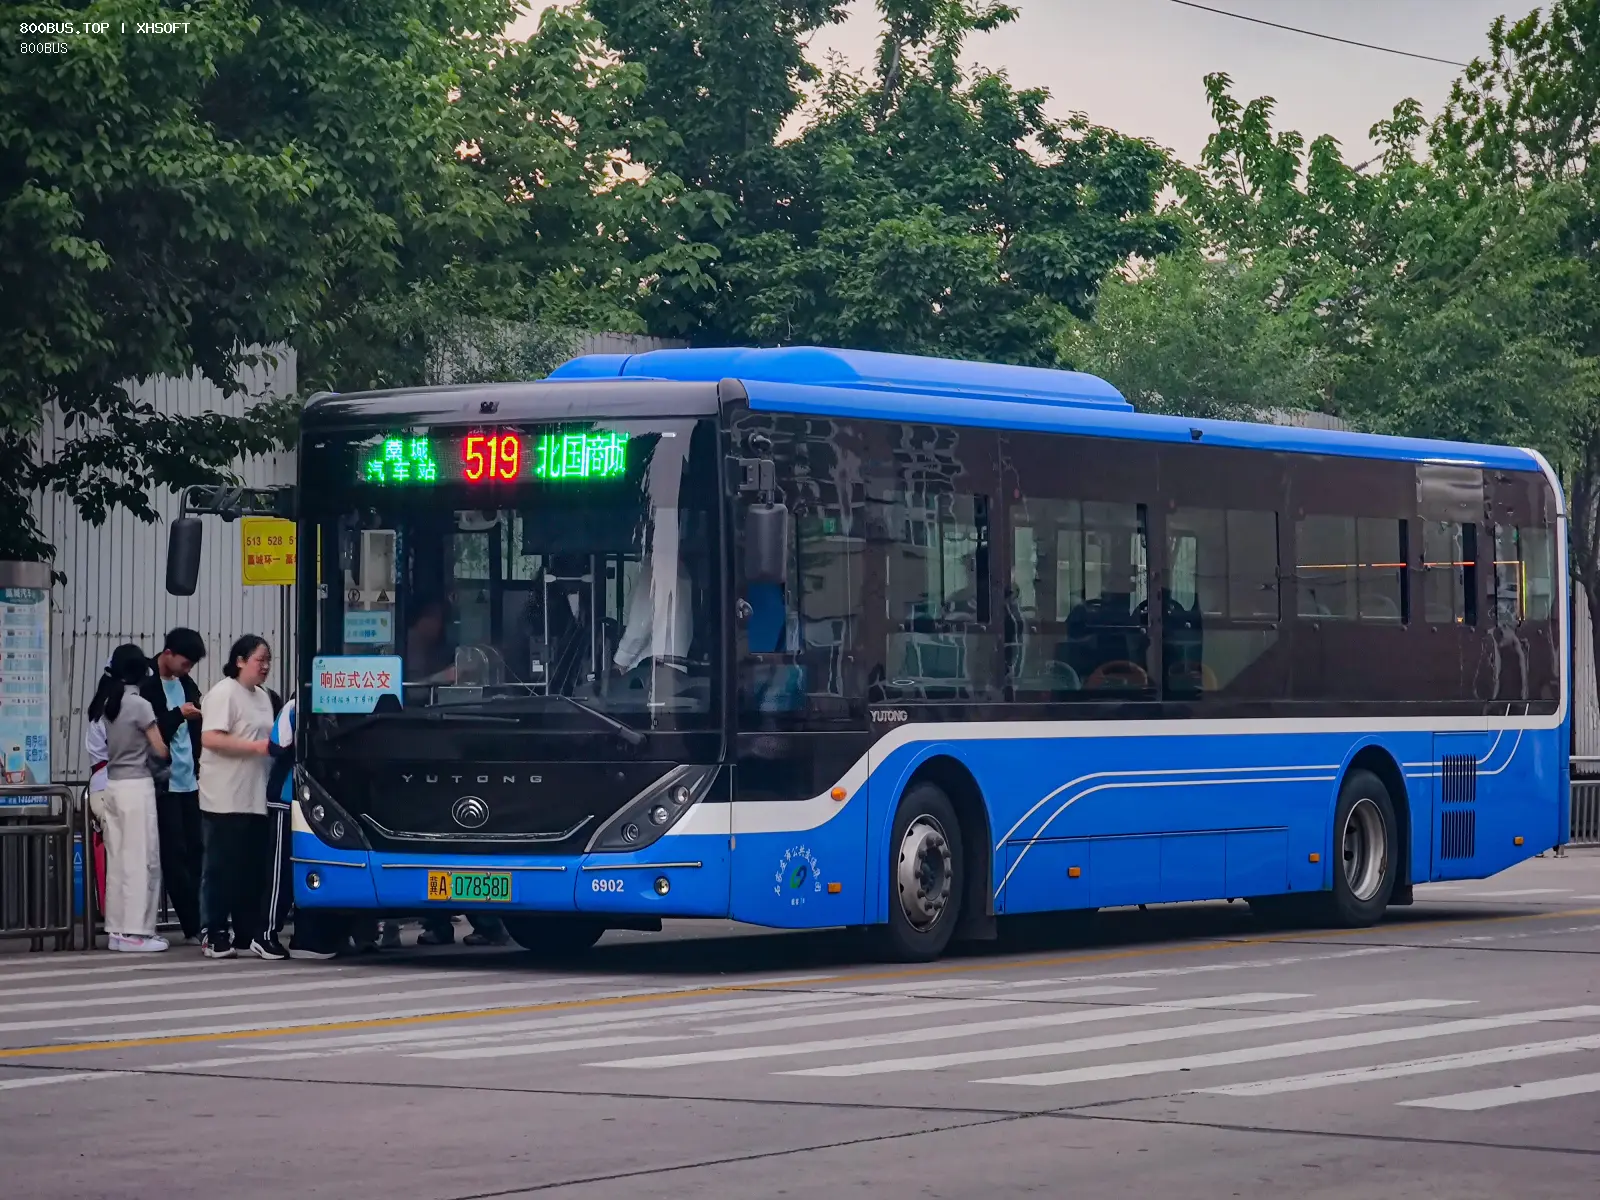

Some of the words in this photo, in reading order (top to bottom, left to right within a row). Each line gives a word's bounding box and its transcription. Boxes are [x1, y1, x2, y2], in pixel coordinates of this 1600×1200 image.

[466, 436, 519, 479] 519
[367, 459, 436, 481] 汽车站
[246, 536, 261, 546] 513
[267, 536, 283, 546] 528
[289, 535, 296, 546] 5
[320, 670, 391, 689] 响应式公交
[869, 710, 908, 722] YUTONG
[401, 774, 543, 783] YUTONG
[591, 878, 625, 893] 6902
